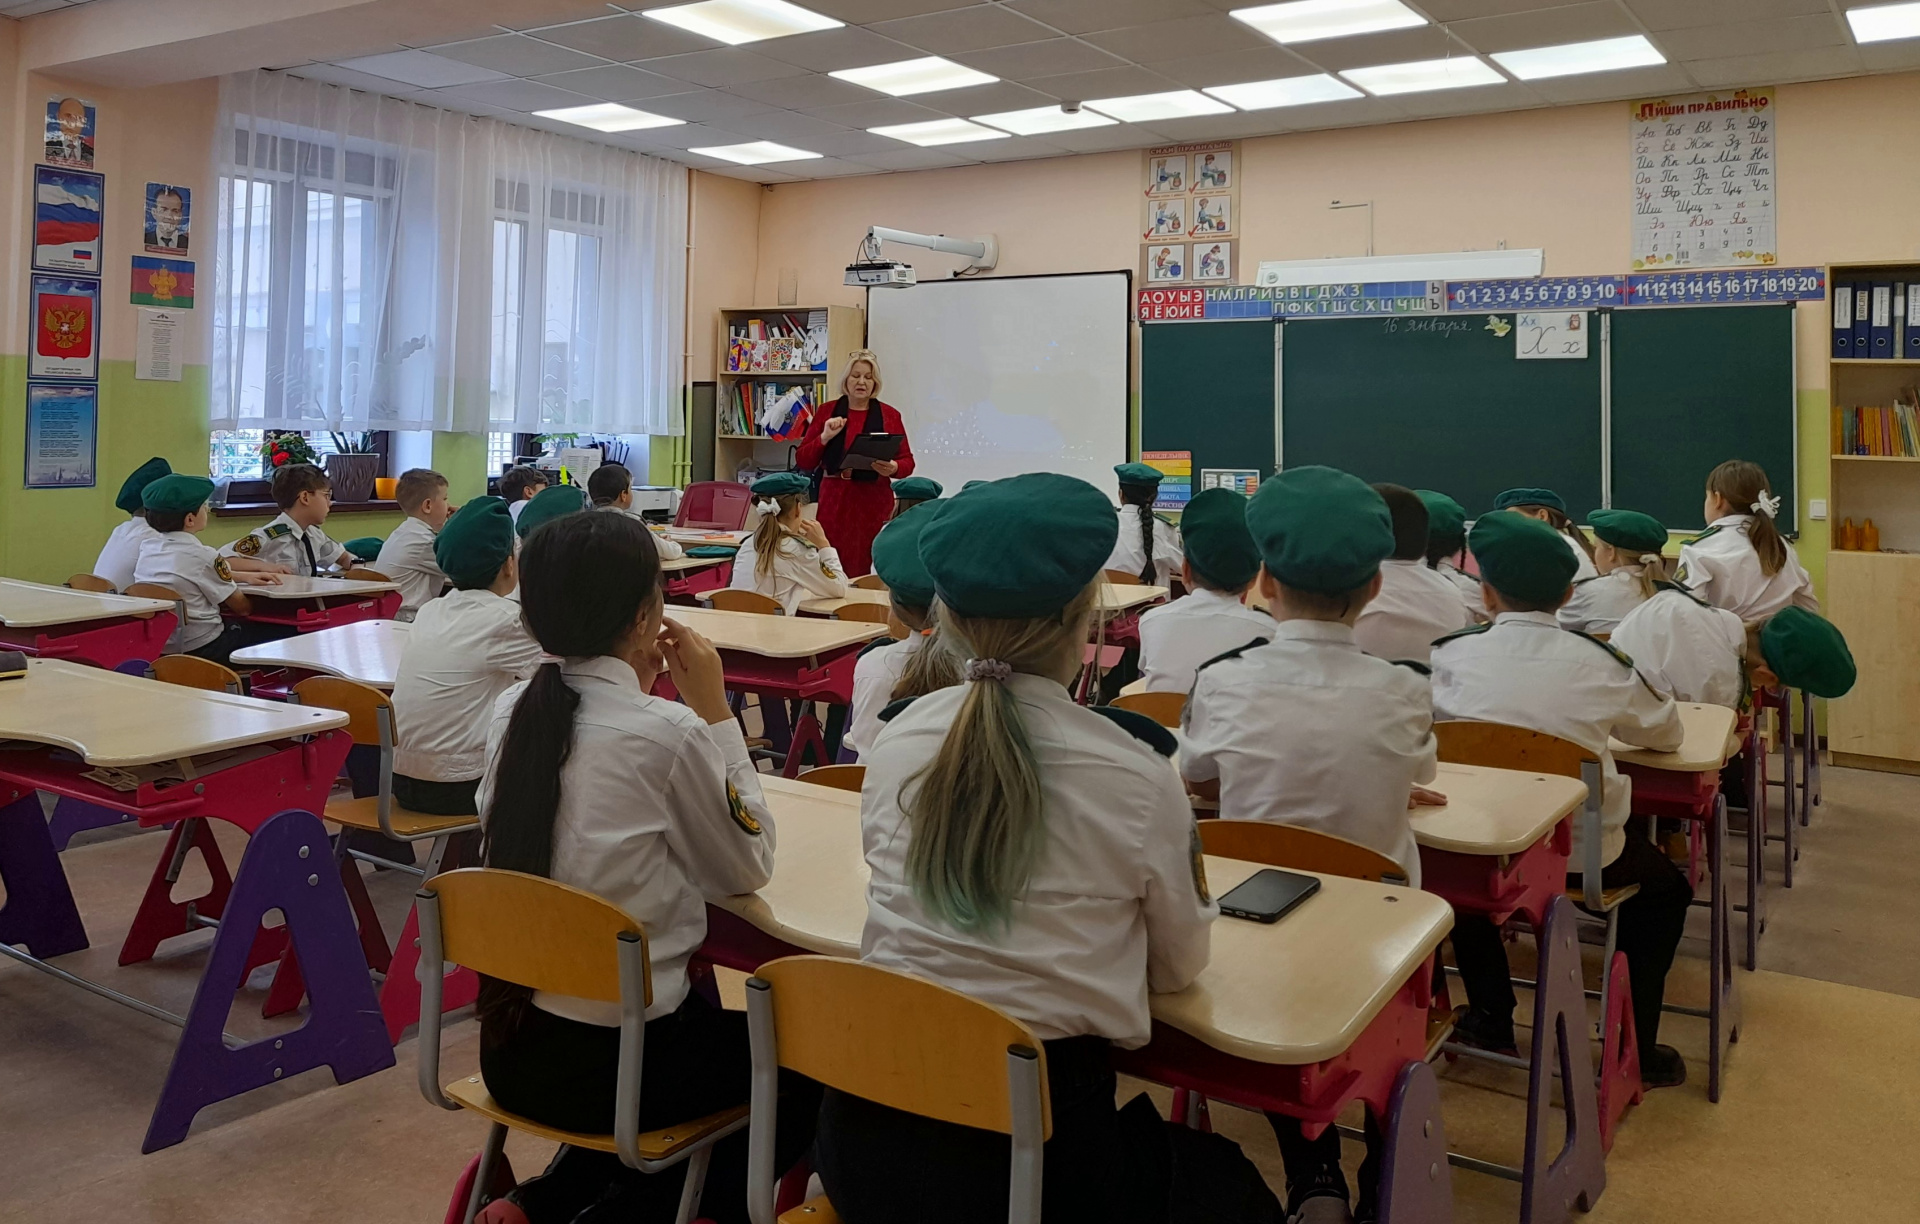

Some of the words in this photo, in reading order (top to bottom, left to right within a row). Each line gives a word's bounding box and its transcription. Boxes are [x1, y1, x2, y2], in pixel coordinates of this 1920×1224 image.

[1688, 96, 1768, 113] ПРАВИЛЬНО
[1747, 116, 1768, 131] Дд
[1457, 290, 1465, 303] 0
[1470, 289, 1476, 302] 1
[1483, 288, 1491, 301] 2
[1496, 288, 1505, 301] 3
[1510, 287, 1520, 300] 4
[1525, 287, 1534, 300] 5
[1540, 286, 1548, 300] 6
[1553, 286, 1562, 299] 7
[1567, 285, 1576, 299] 8
[1582, 284, 1591, 299] 9
[1596, 284, 1614, 298] 10
[1635, 283, 1650, 296] 11
[1652, 283, 1667, 296] 12
[1670, 282, 1685, 295] 13
[1687, 281, 1703, 295] 14
[1706, 281, 1721, 294] 15
[1724, 280, 1740, 293] 16
[1743, 279, 1758, 293] 17
[1761, 279, 1777, 292] 18
[1779, 278, 1795, 291] 19
[1799, 276, 1817, 291] 20
[1383, 318, 1398, 333] 16
